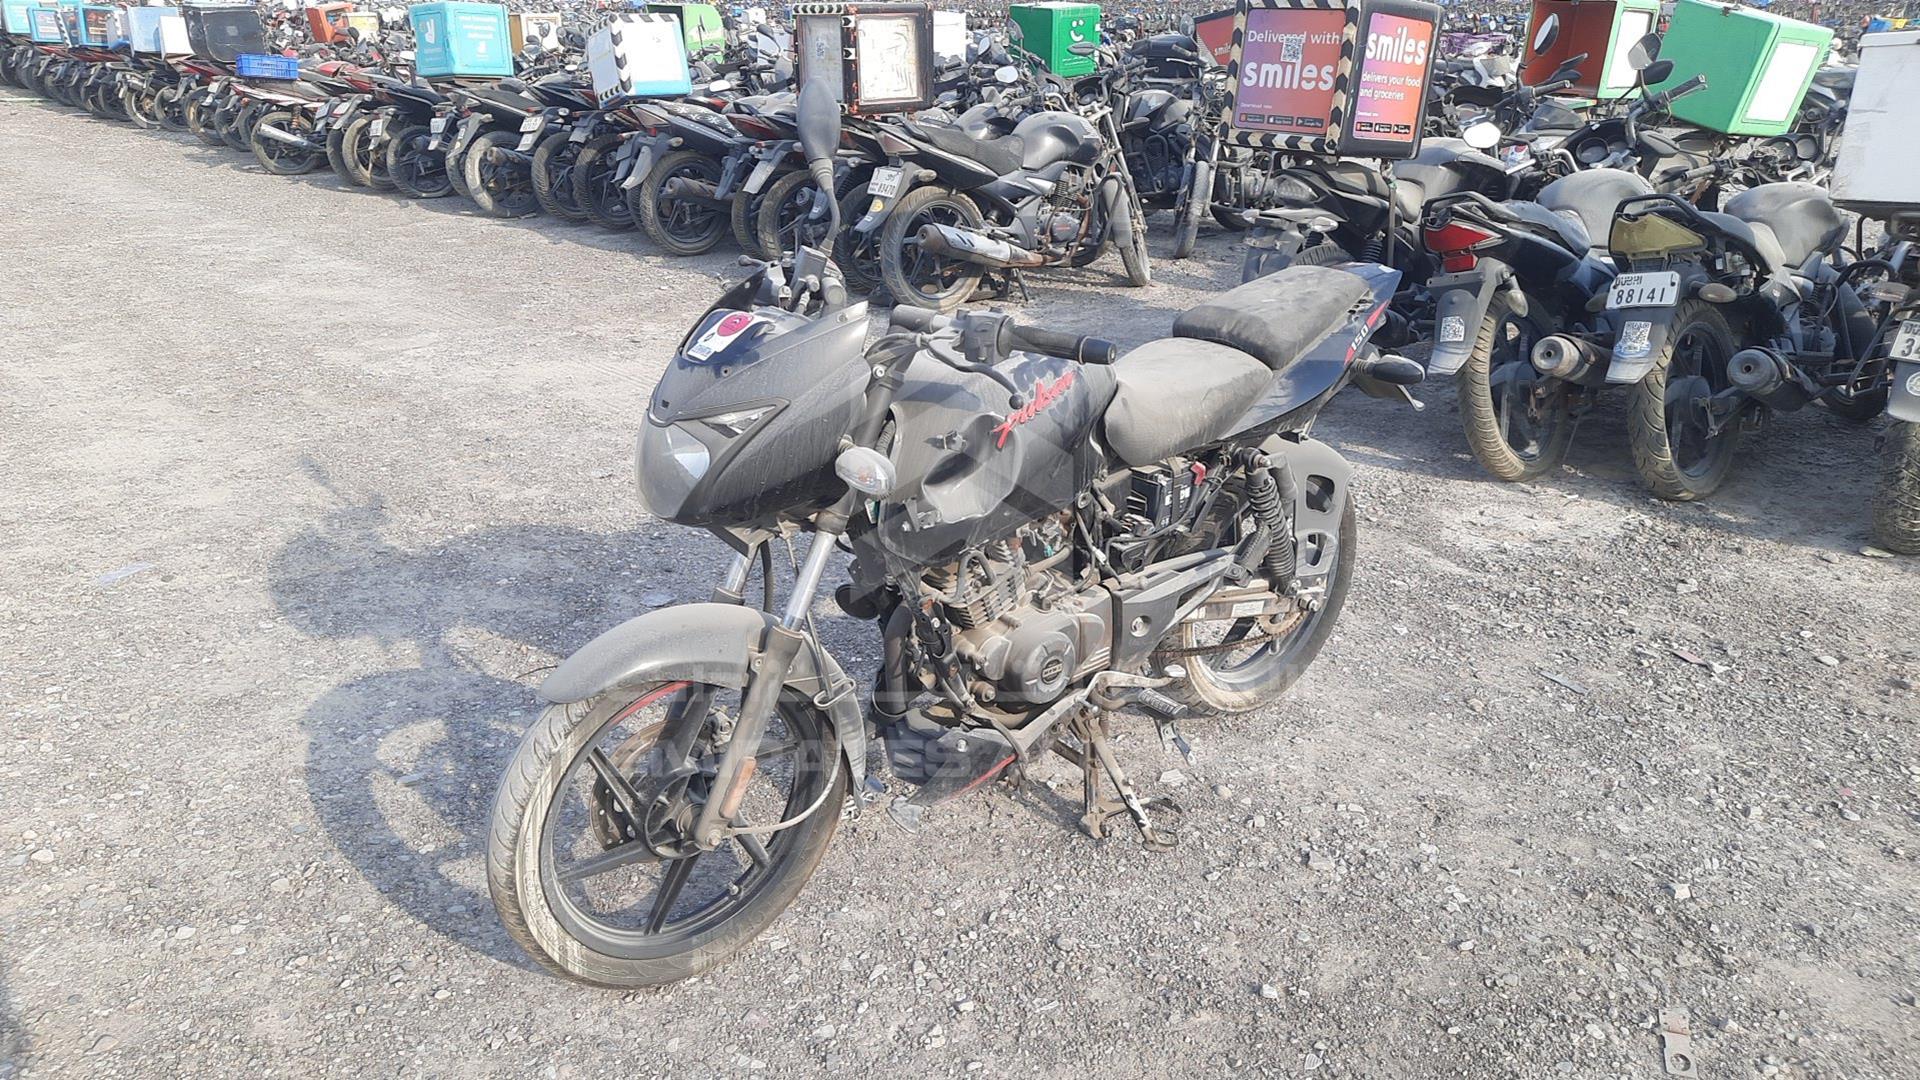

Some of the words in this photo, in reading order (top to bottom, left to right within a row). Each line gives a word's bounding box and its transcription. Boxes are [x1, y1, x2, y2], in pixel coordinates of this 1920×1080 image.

[1310, 32, 1340, 44] with
[1366, 26, 1426, 65] smiles
[1243, 57, 1335, 91] smiles
[1362, 71, 1388, 84] delivers
[1388, 75, 1404, 86] your
[1406, 75, 1421, 87] food
[1359, 87, 1373, 97] and
[1373, 90, 1405, 100] groceries
[1615, 287, 1665, 305] 88141
[1351, 324, 1369, 351] 150
